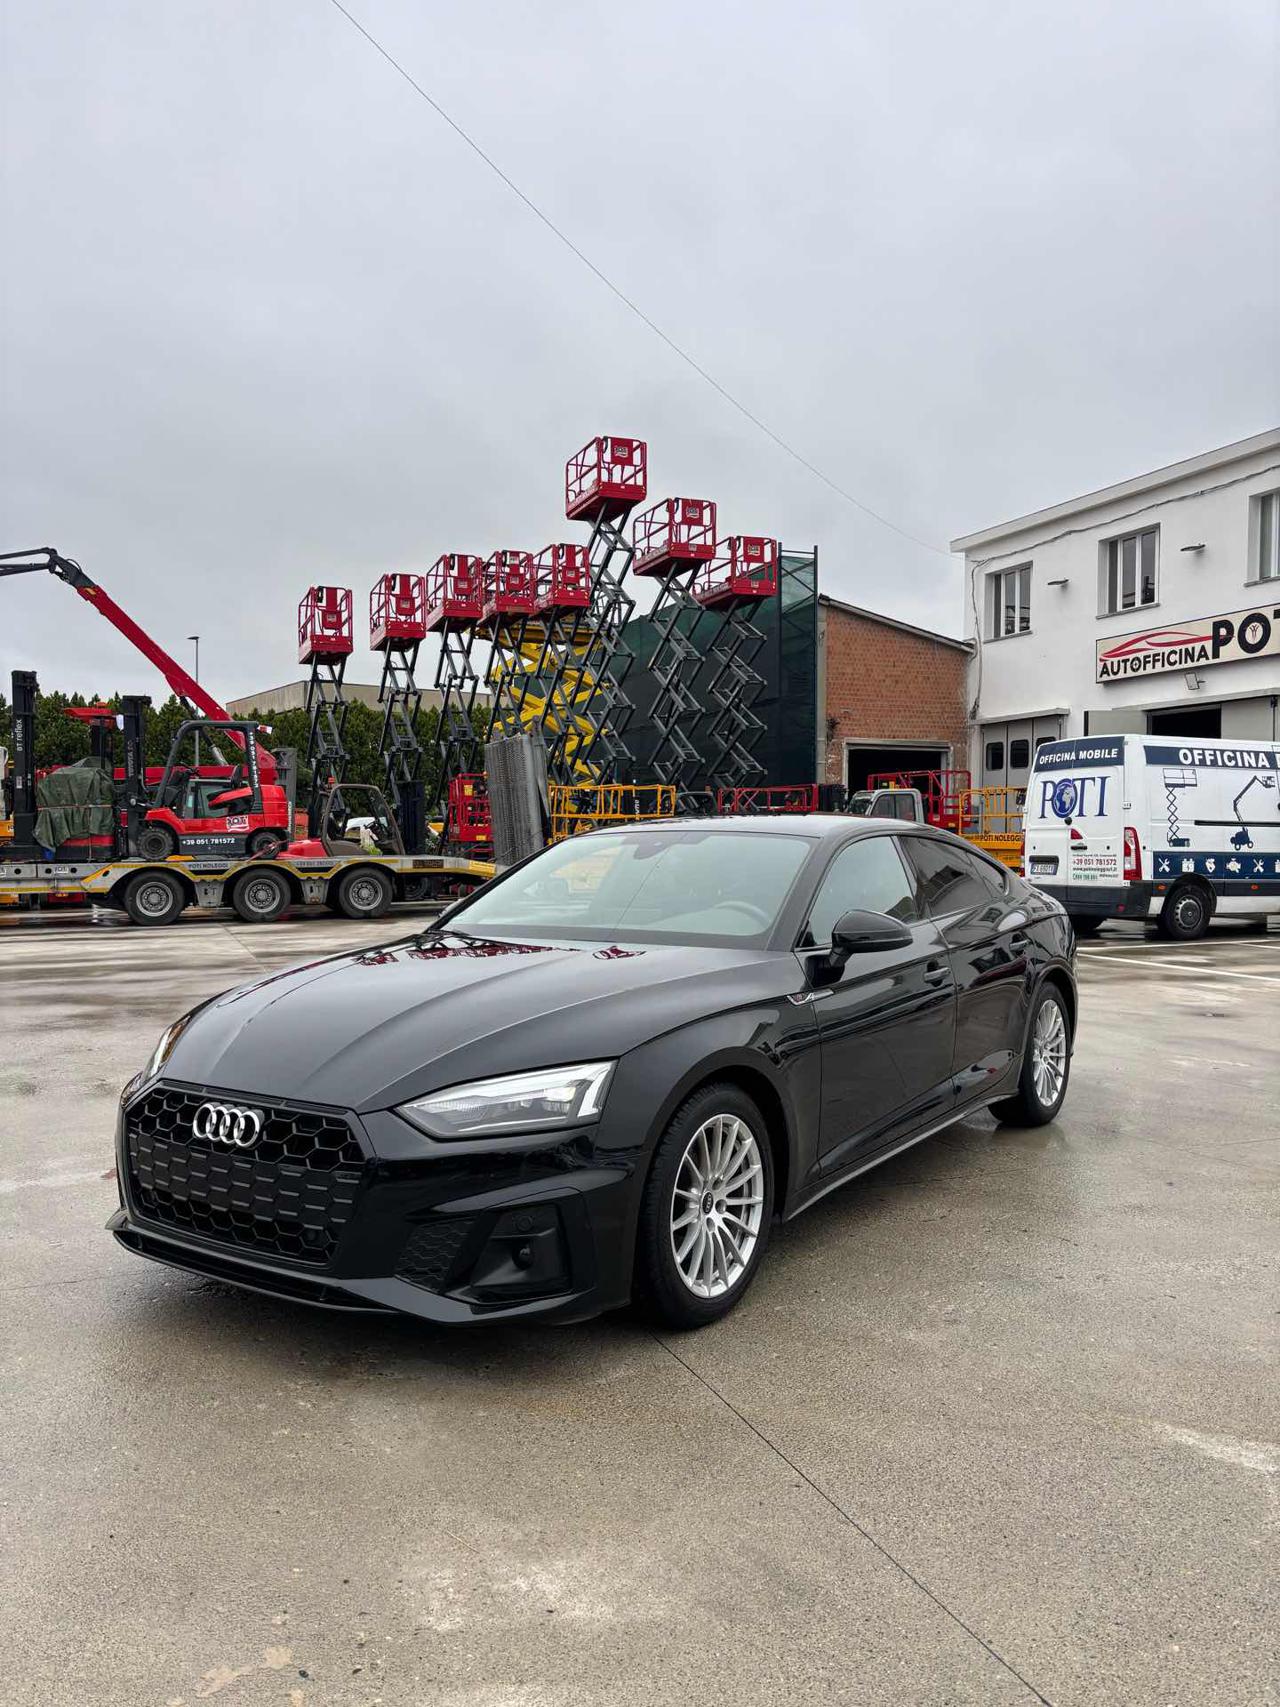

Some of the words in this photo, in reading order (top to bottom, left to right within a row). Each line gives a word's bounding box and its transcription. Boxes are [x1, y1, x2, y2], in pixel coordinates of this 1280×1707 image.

[1099, 644, 1209, 678] AUTOFFICINA
[1039, 751, 1076, 765] OFFICINA
[1078, 748, 1119, 760] MOBILE
[1178, 748, 1271, 768] OFFICINA
[1038, 775, 1111, 820] POTI
[1084, 858, 1094, 866] 051
[1095, 858, 1117, 866] 781572
